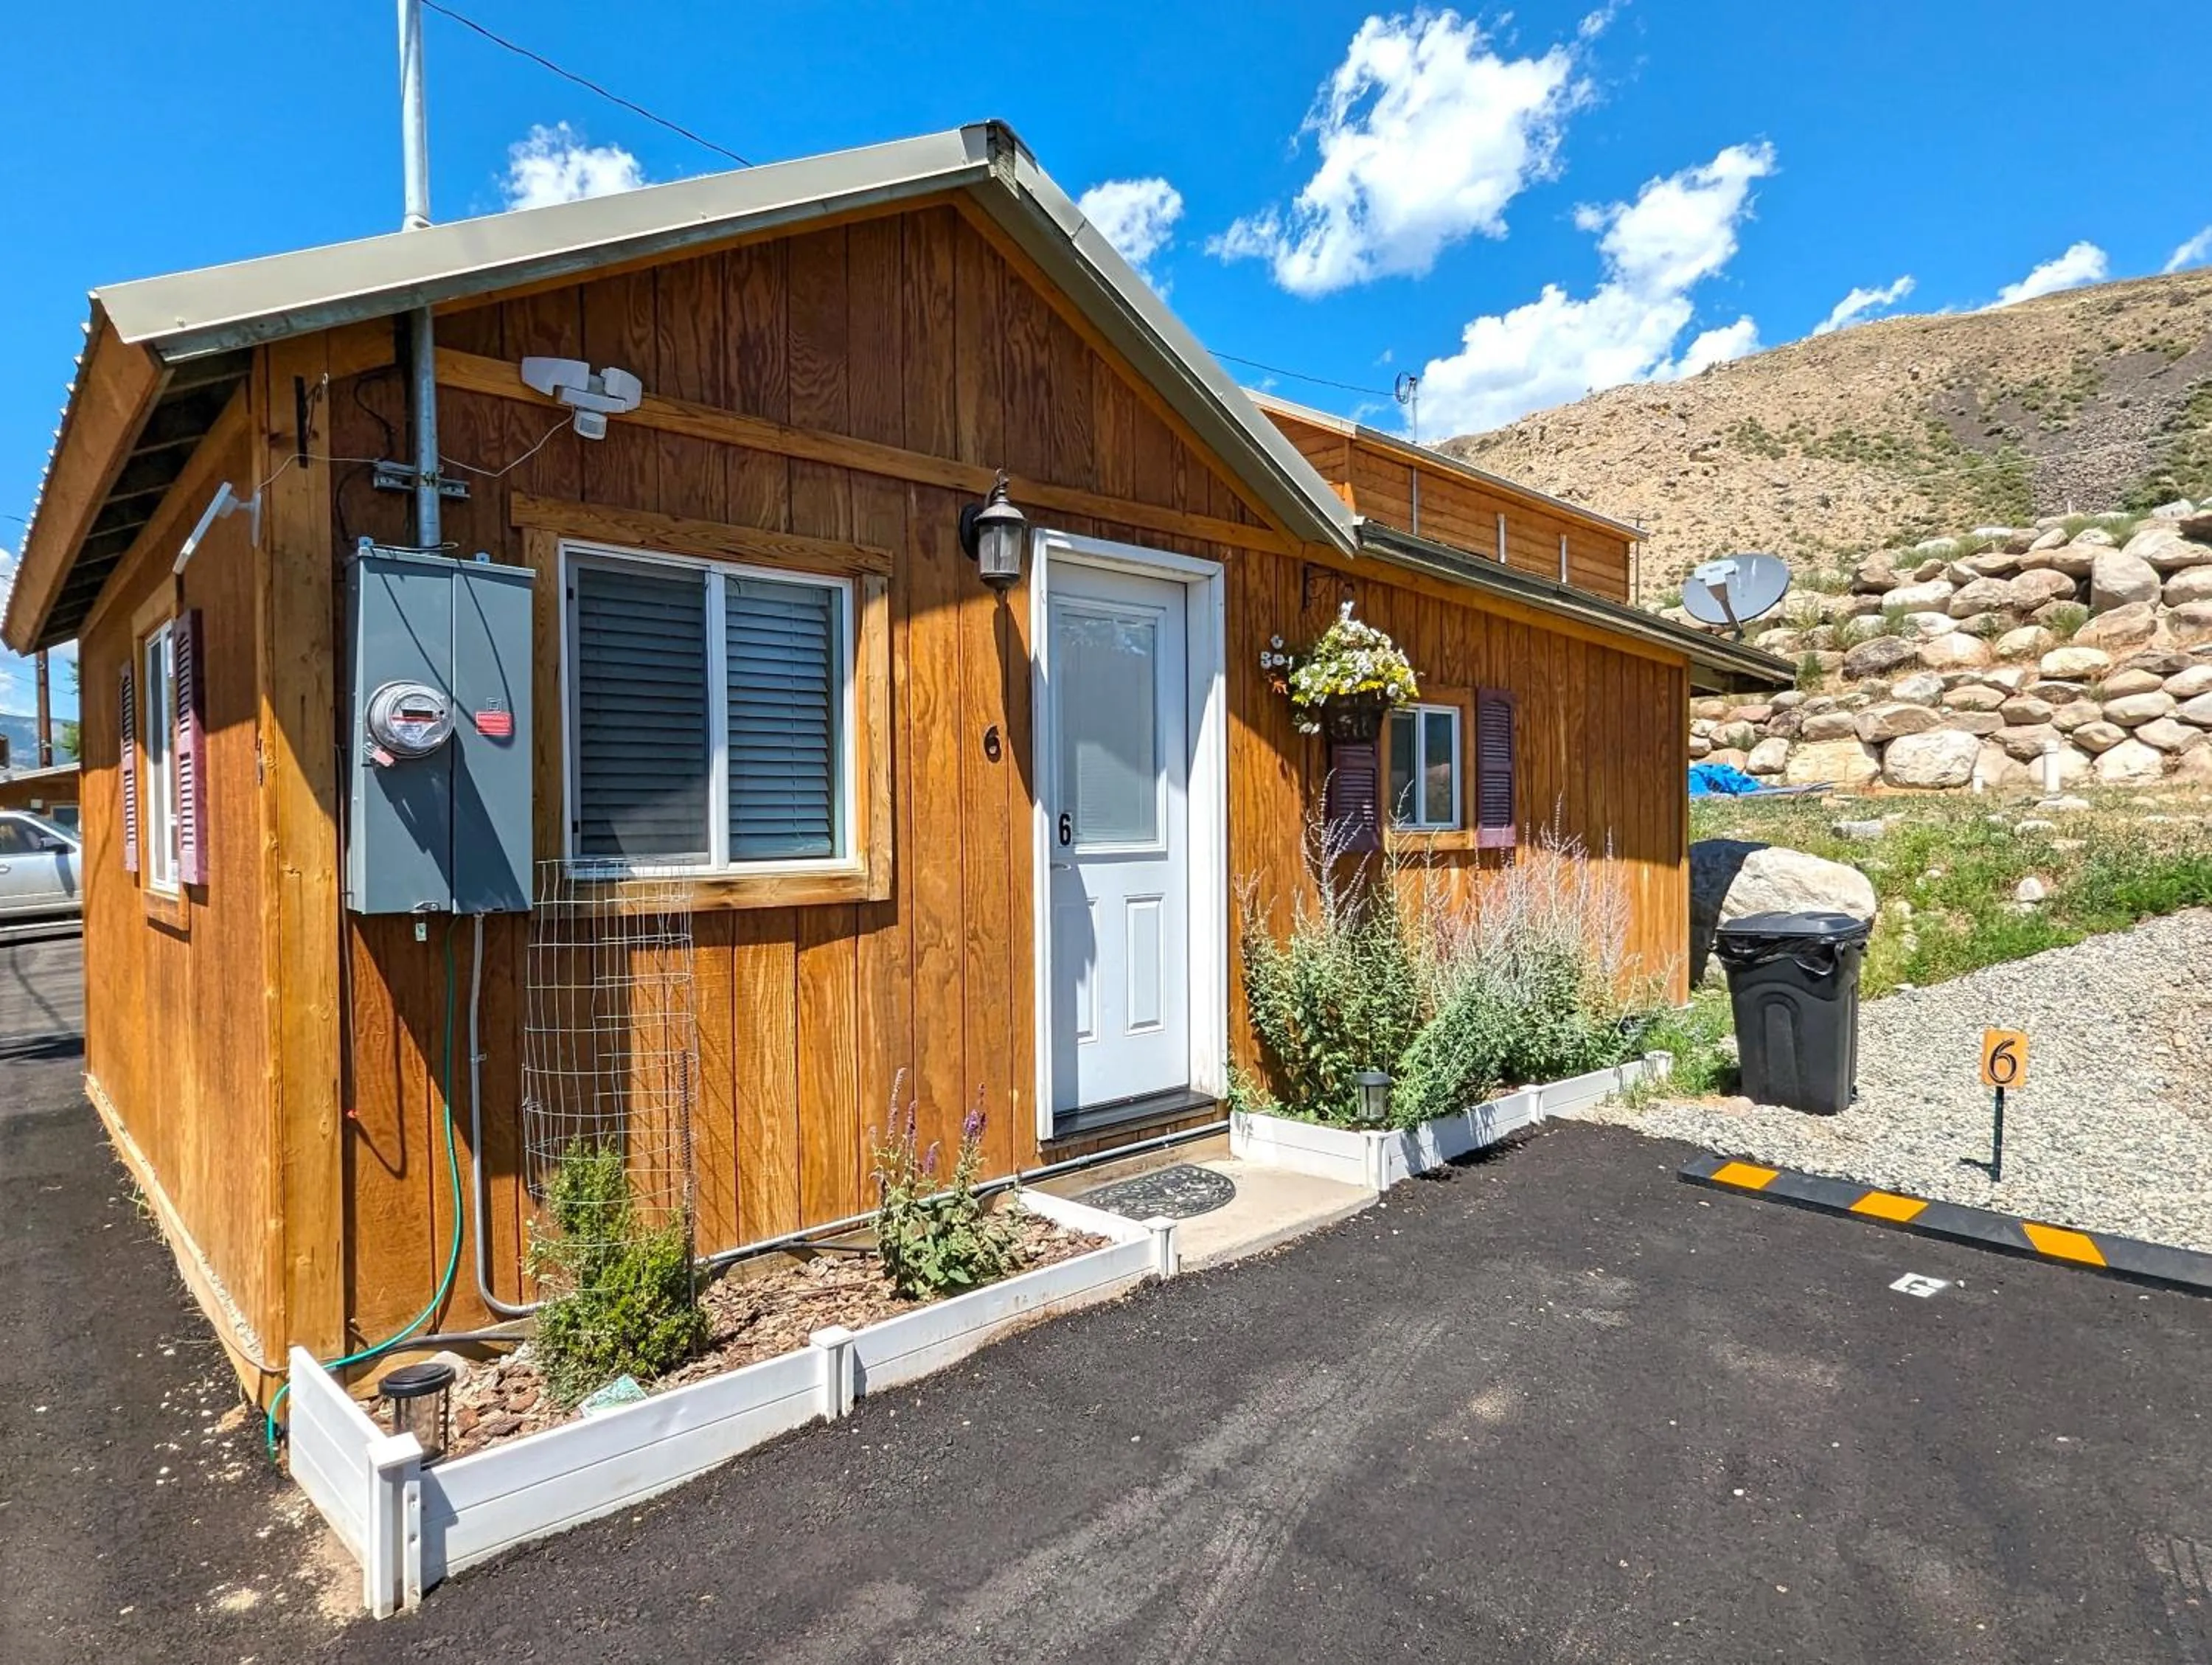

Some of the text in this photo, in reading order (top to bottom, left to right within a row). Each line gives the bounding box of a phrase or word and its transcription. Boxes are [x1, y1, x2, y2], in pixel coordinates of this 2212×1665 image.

[984, 725, 1001, 762] 6
[1059, 813, 1071, 846] 6
[1989, 1037, 2017, 1084] 6
